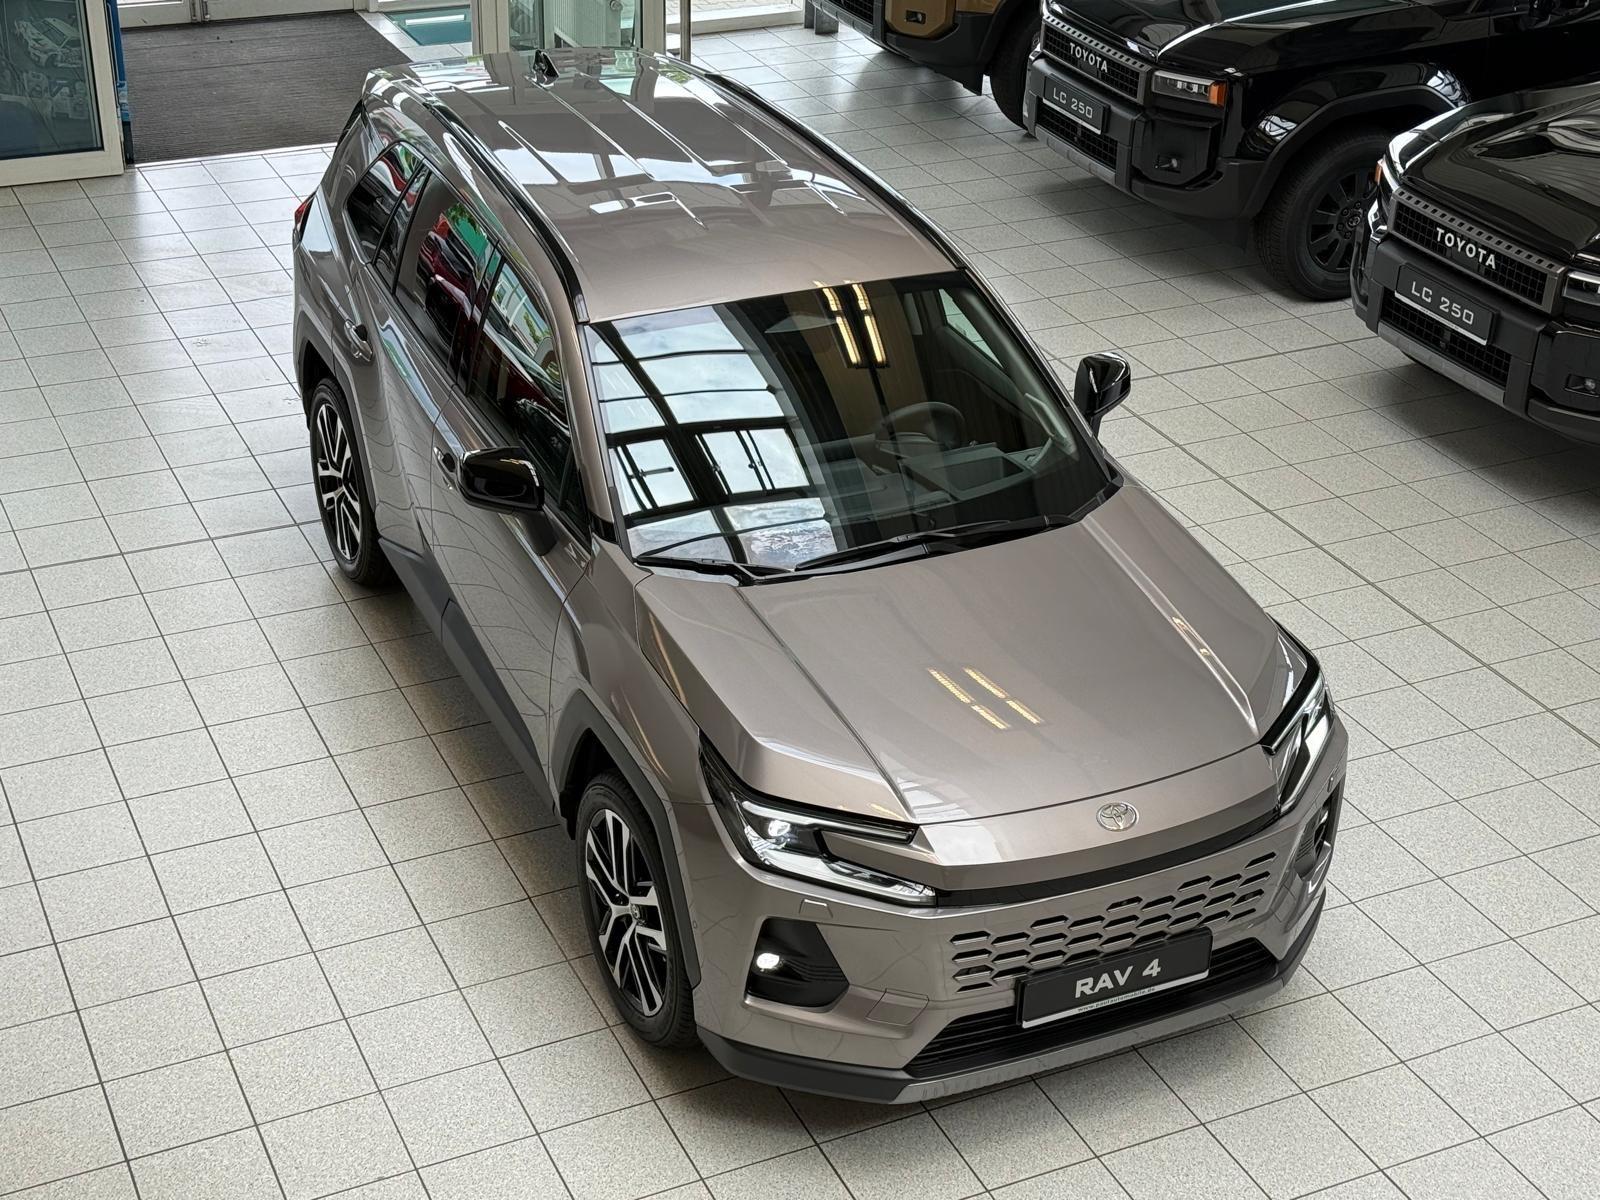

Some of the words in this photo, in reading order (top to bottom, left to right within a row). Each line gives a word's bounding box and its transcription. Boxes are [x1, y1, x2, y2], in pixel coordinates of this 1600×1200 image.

[1069, 42, 1108, 73] TOYOTA
[1053, 87, 1067, 104] LC
[1071, 98, 1093, 119] 250
[1436, 227, 1496, 269] TOYOTA
[1411, 281, 1432, 303] LC
[1440, 296, 1474, 325] 250
[1075, 965, 1134, 998] RAV
[1142, 958, 1161, 977] 4
